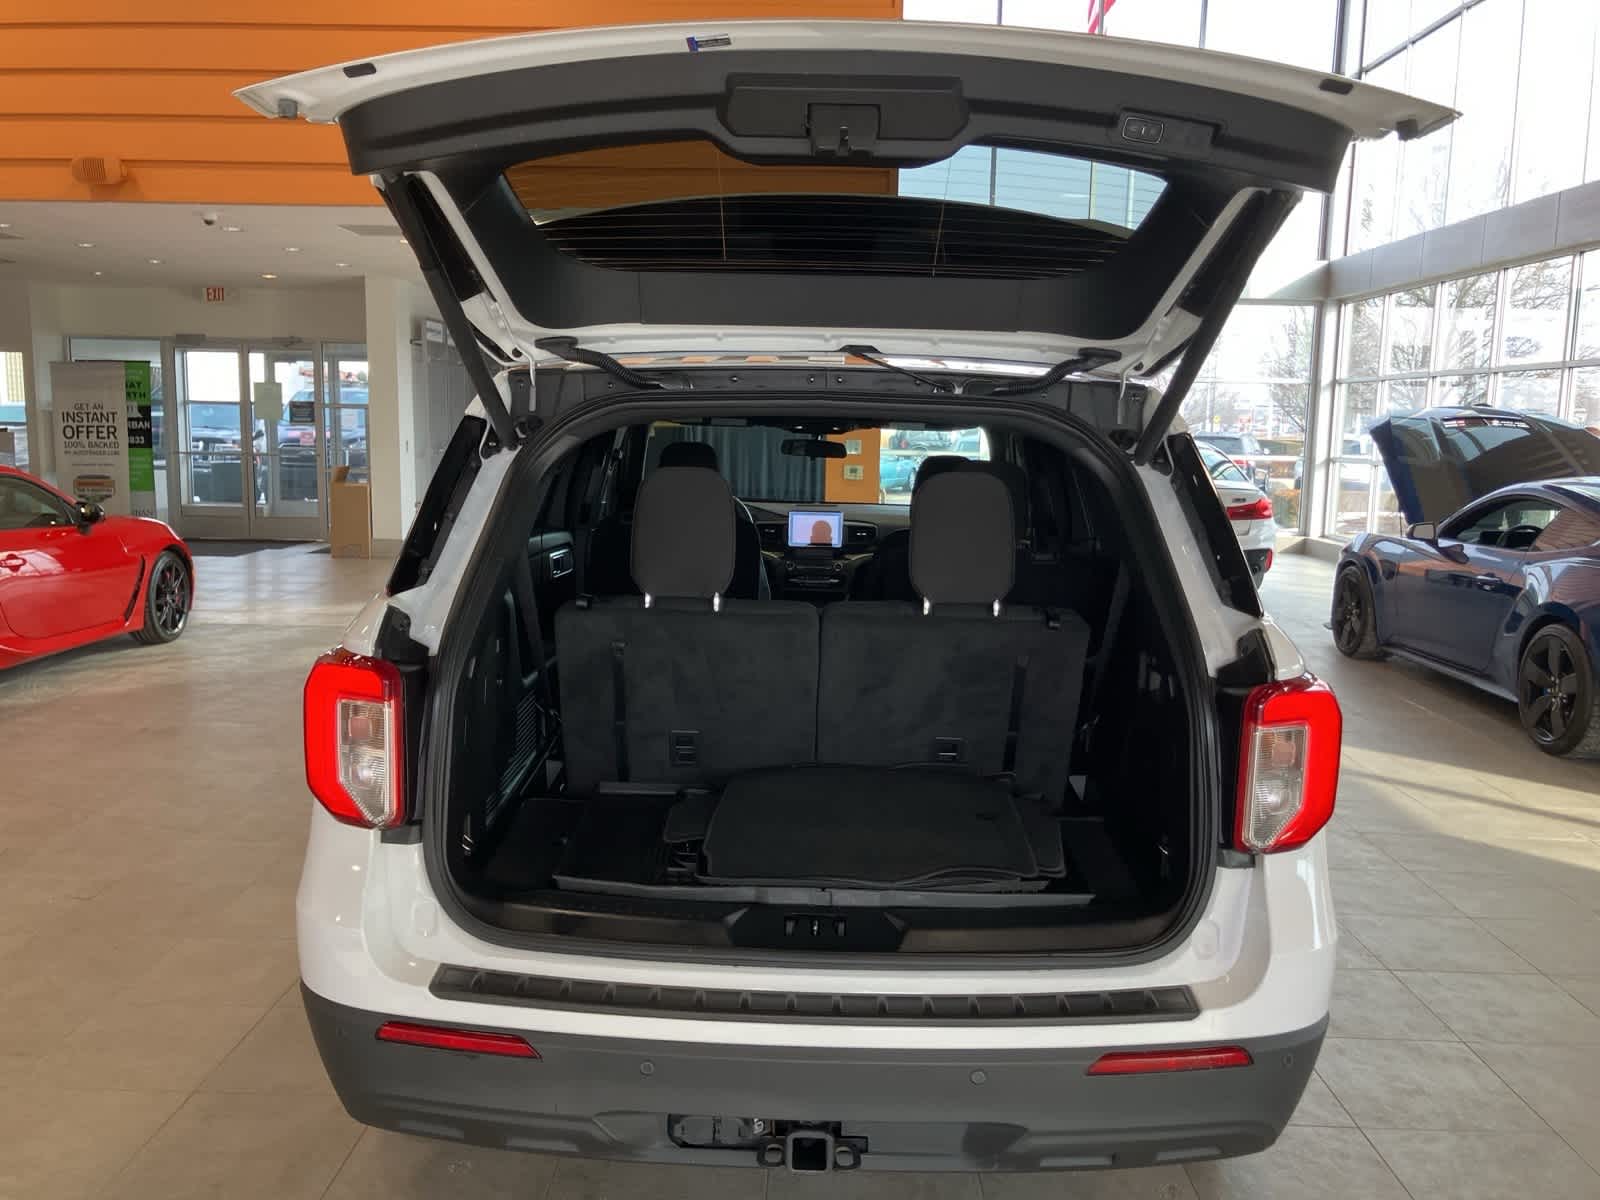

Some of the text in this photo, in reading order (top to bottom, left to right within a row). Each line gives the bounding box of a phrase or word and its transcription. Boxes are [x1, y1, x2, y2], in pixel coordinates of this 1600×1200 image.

[207, 287, 225, 302] EXIT
[62, 411, 118, 424] INSTANT
[63, 424, 118, 440] OFFER
[64, 441, 120, 449] 100% BACKED
